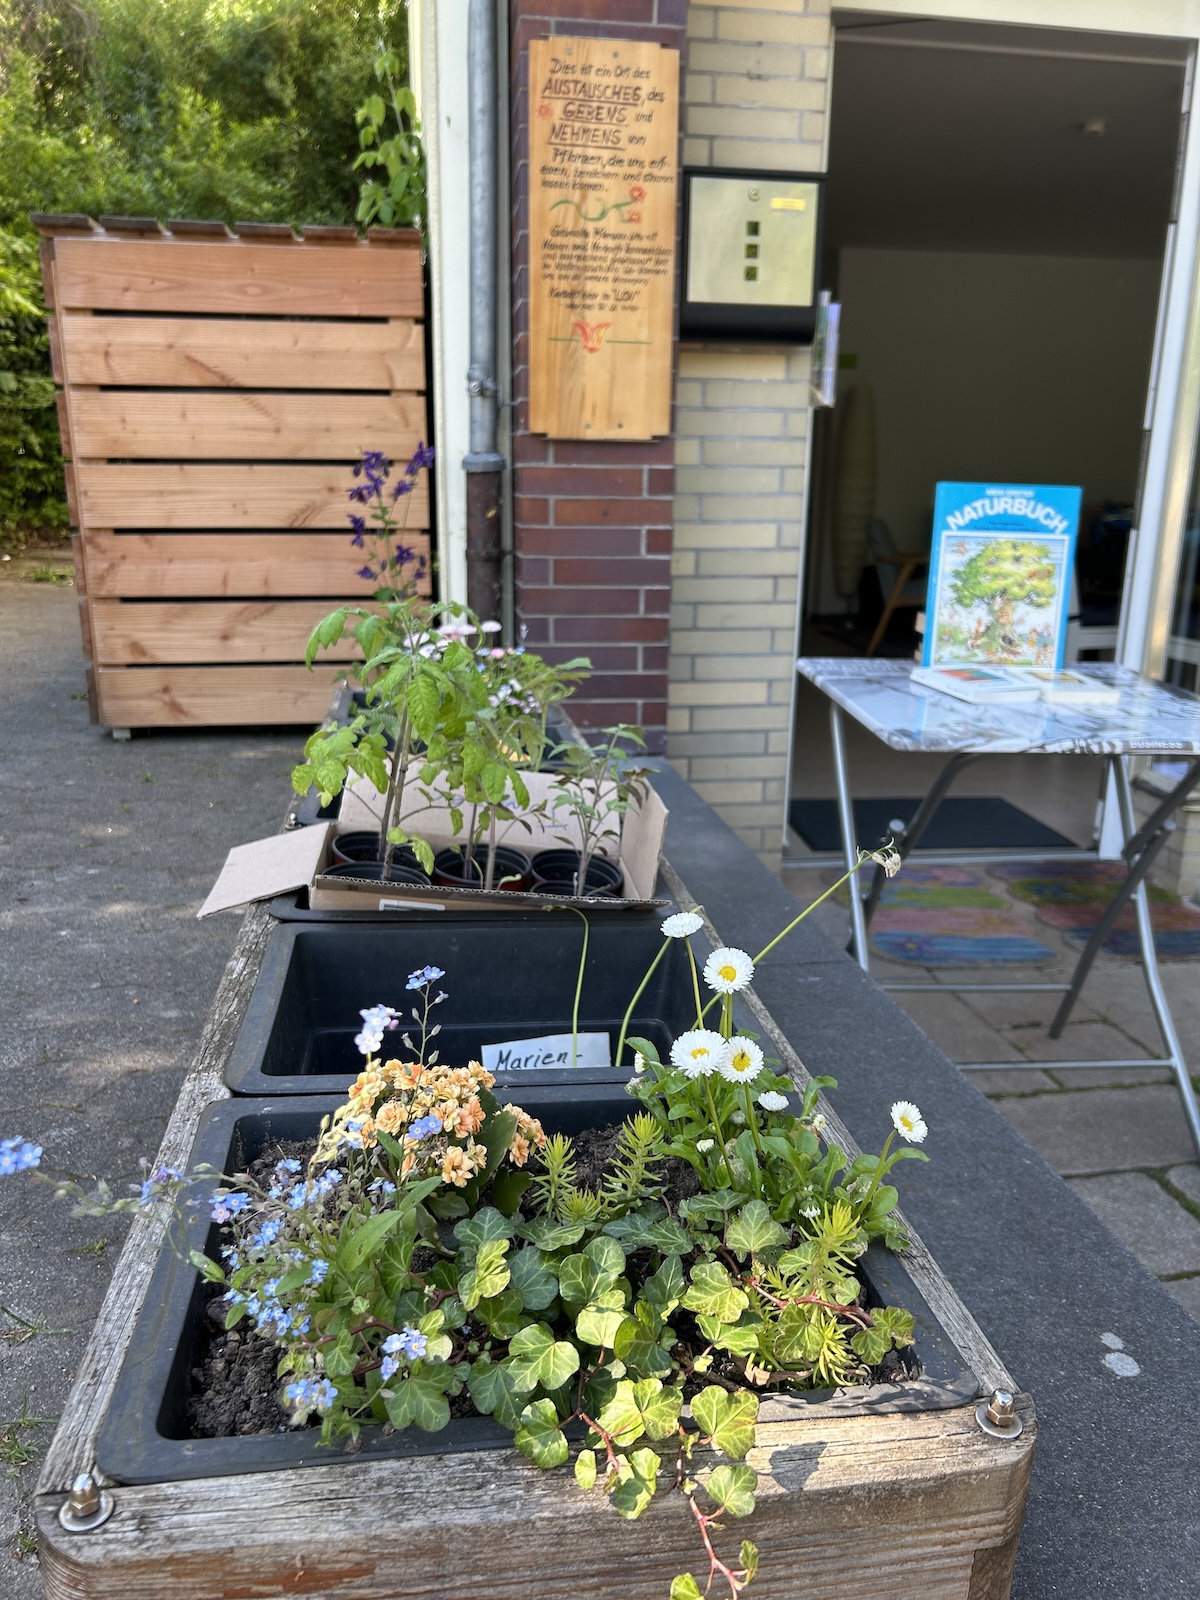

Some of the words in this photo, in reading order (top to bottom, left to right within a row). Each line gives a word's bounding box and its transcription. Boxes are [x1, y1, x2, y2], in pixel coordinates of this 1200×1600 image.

[550, 58, 577, 74] Dies
[595, 65, 612, 77] ein
[614, 64, 631, 77] Ort
[633, 67, 651, 79] des
[646, 86, 666, 103] des
[563, 101, 627, 123] GEBENS
[635, 110, 654, 123] und
[550, 123, 623, 145] NEHMENS
[607, 153, 625, 167] die
[946, 498, 1069, 535] NATURBUCH
[1129, 740, 1183, 749] BUSINESS
